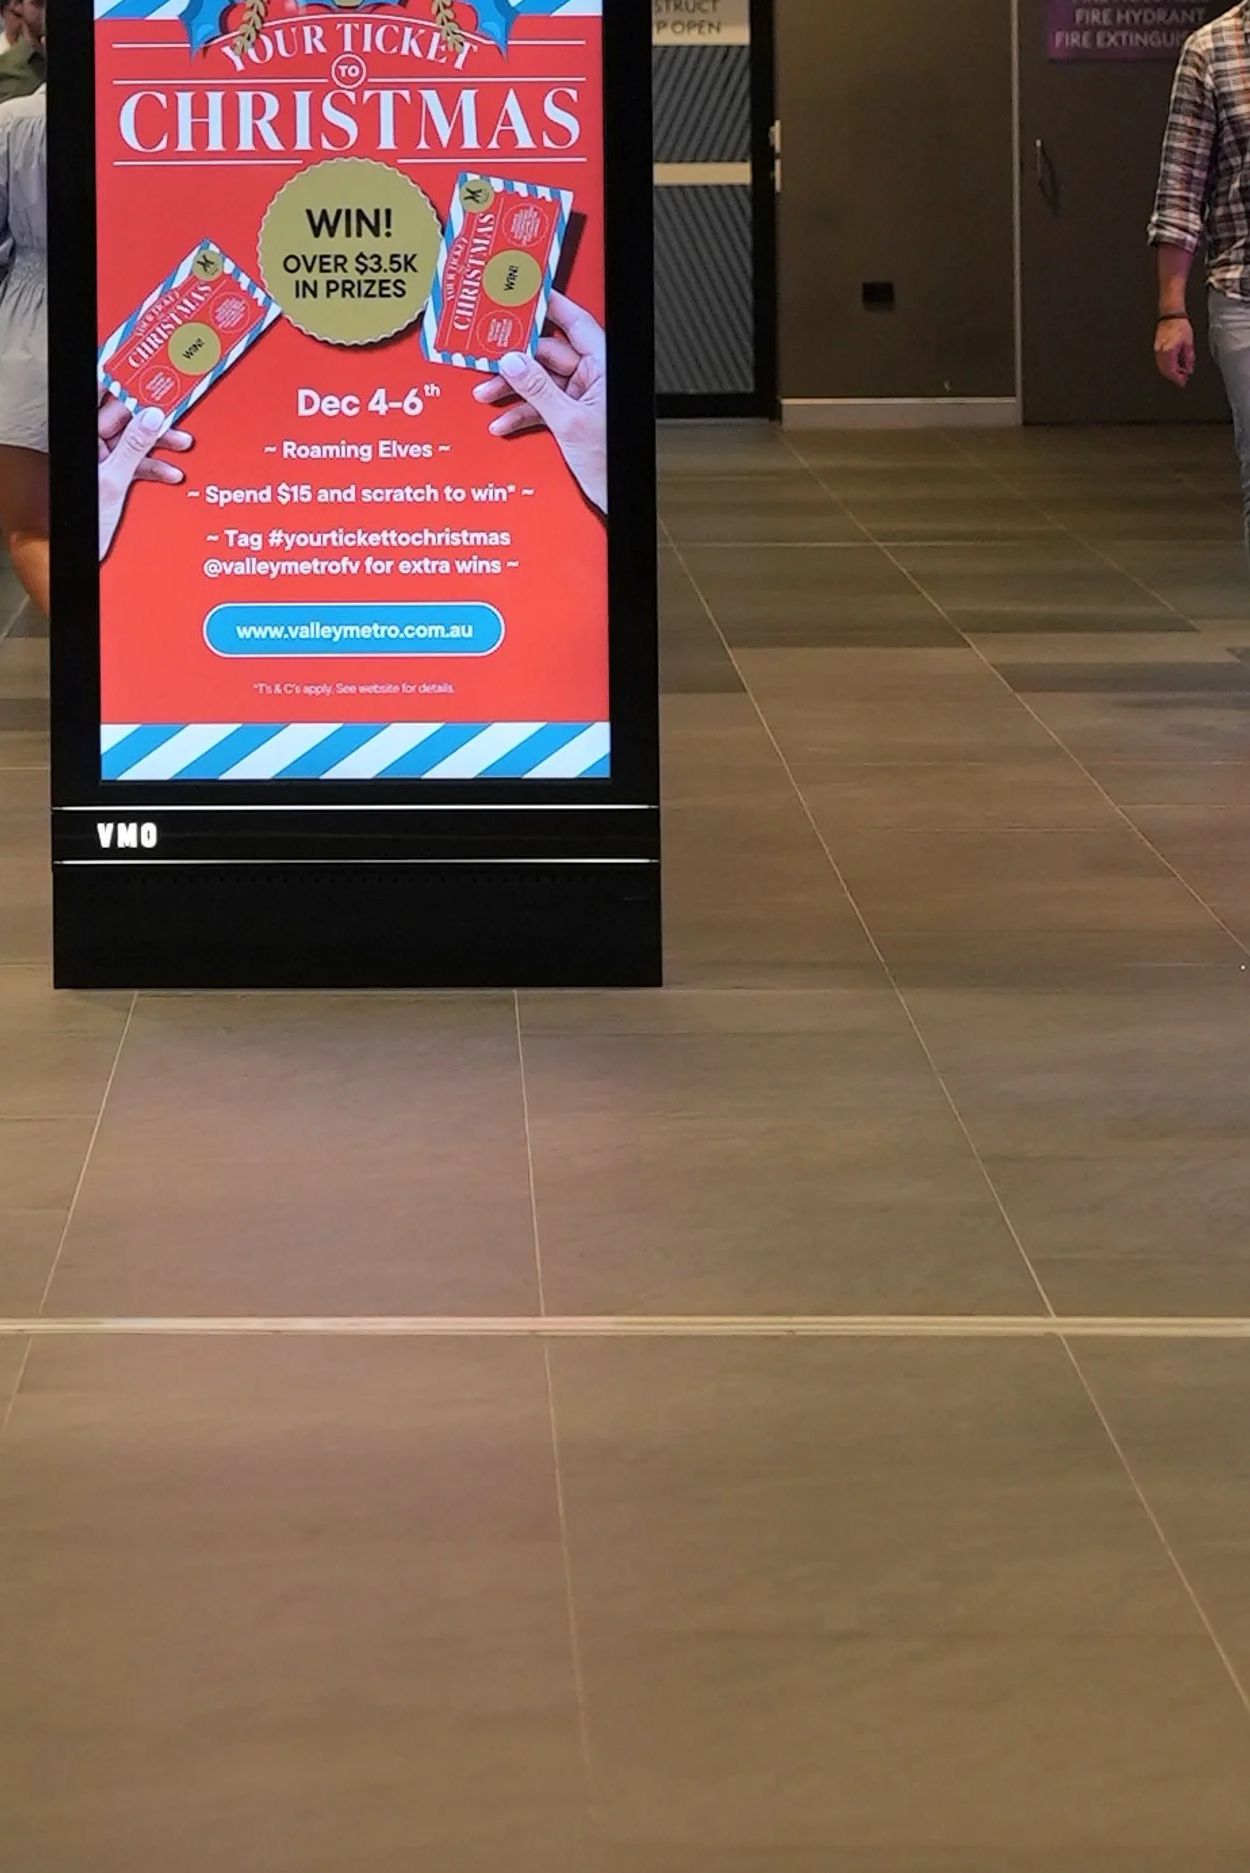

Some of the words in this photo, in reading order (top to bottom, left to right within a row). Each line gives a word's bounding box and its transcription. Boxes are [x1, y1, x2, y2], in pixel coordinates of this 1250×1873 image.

[1075, 9, 1112, 25] FIRE
[1116, 8, 1206, 25] HYDRANT
[221, 25, 324, 72] YOUR
[335, 23, 479, 71] TICKET
[1055, 31, 1092, 47] FIRE
[1097, 31, 1186, 48] EXTINGUI
[338, 63, 359, 79] TO
[119, 87, 579, 152] CHRISTMAS
[306, 208, 392, 239] WIN!
[283, 254, 348, 274] OVER
[355, 253, 418, 274] $3.5K
[453, 213, 494, 330] CHRISTMAS
[295, 280, 318, 298] IN
[326, 278, 405, 298] PRIZES
[297, 389, 359, 417] Dec
[283, 441, 372, 461] Roaming
[379, 440, 433, 459] Elves
[205, 486, 271, 505] Spend
[278, 484, 311, 505] $15
[317, 485, 356, 503] and
[361, 484, 438, 503] scratch
[444, 486, 465, 503] to
[224, 530, 263, 550] Tag
[268, 528, 510, 549] #yourtickettochristmas
[203, 557, 359, 577] @valleymetrofv
[365, 557, 393, 574] for
[399, 558, 450, 574] extra
[455, 557, 501, 574] wins
[236, 621, 473, 641] www.valleymetro.com.au
[402, 682, 415, 693] for
[97, 823, 157, 849] VMO
